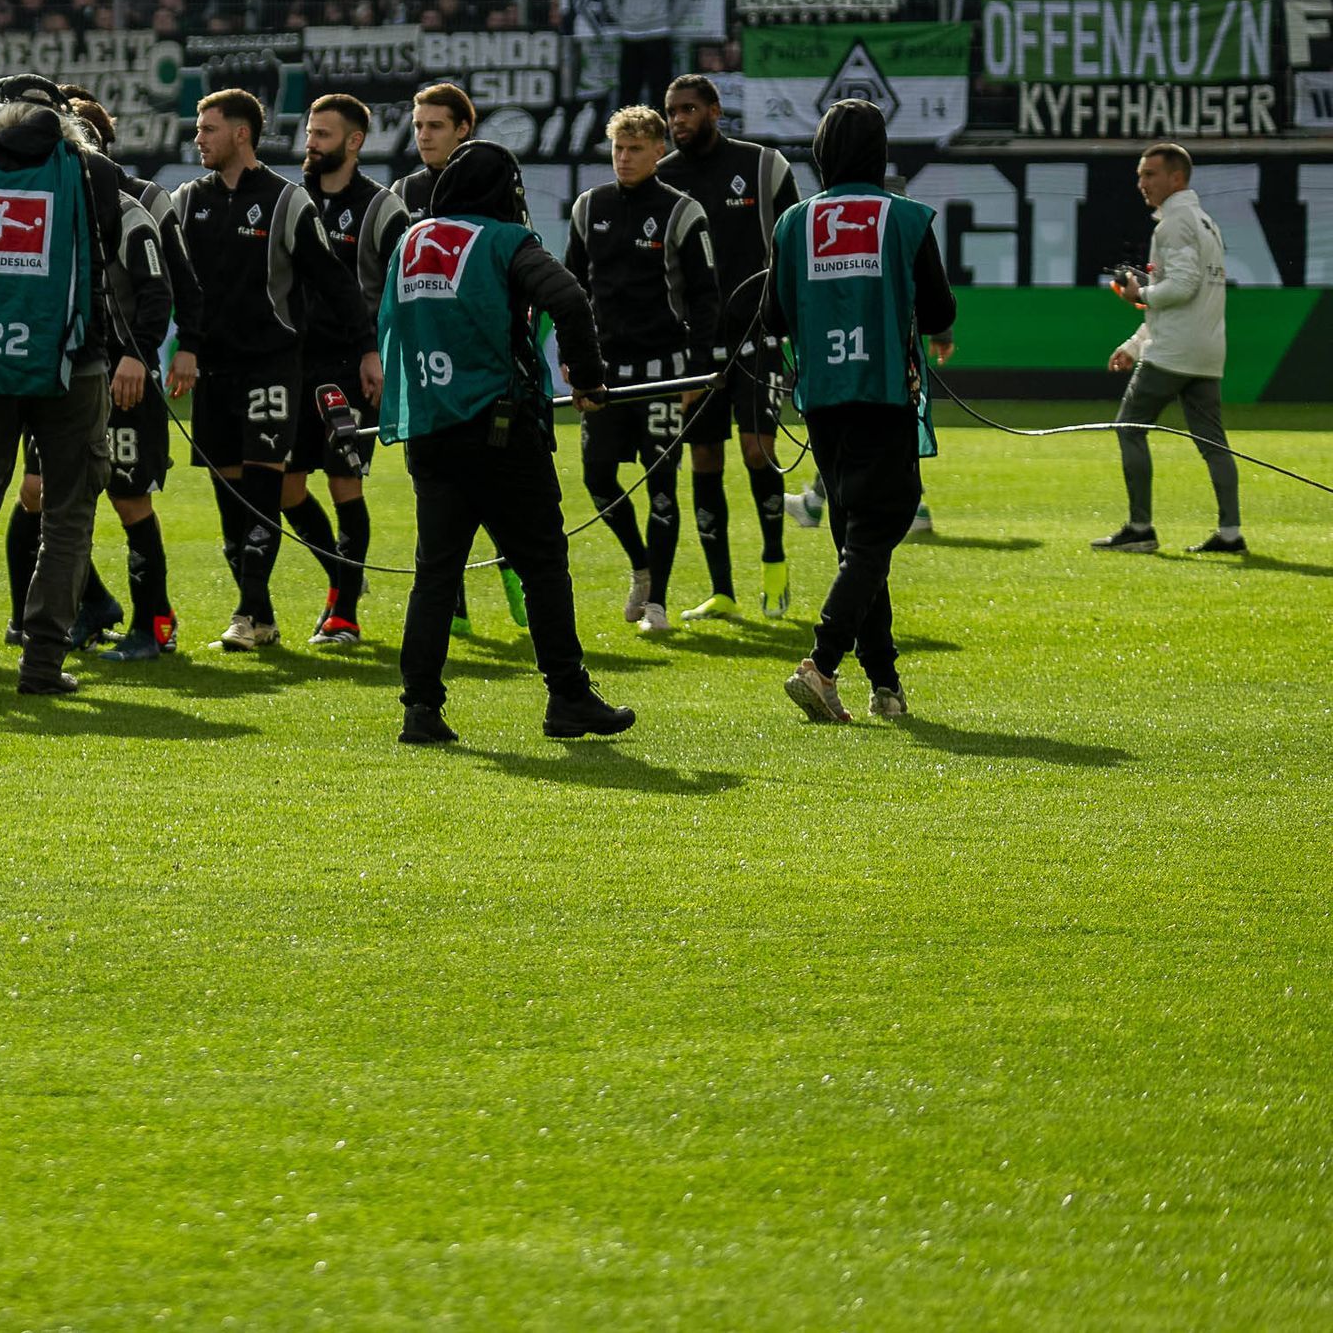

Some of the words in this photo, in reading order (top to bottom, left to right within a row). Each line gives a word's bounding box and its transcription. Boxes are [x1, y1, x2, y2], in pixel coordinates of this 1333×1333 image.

[421, 32, 559, 68] BANDA
[985, 0, 1272, 78] OFFENAU/N
[1018, 81, 1277, 137] KYFFHÄUSER
[813, 259, 880, 274] BUNDESLIGA
[826, 326, 870, 365] 31
[416, 350, 454, 389] 39
[247, 385, 290, 421] 29
[648, 402, 683, 437] 25
